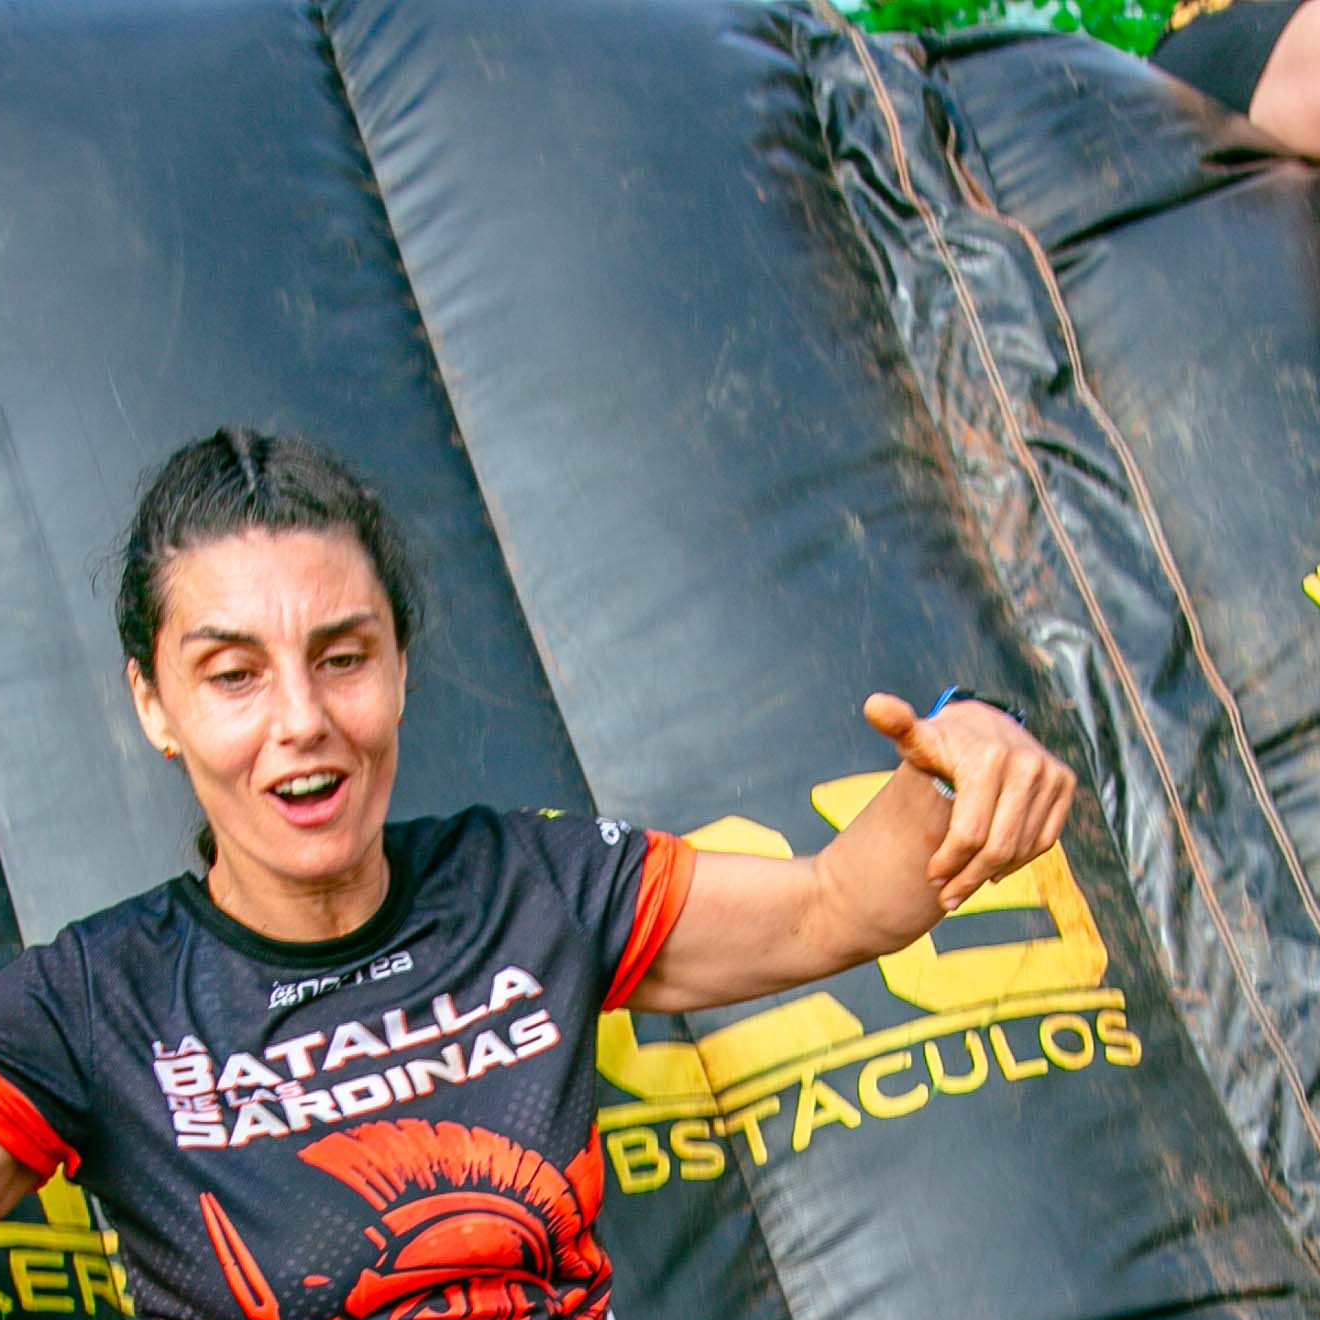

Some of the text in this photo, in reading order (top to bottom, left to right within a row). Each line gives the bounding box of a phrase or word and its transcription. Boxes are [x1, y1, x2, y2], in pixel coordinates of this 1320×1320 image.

[152, 1033, 208, 1059] LA
[153, 965, 545, 1098] BATALLA
[166, 1078, 306, 1114] DE LAS
[172, 1008, 563, 1150] SARDINAS
